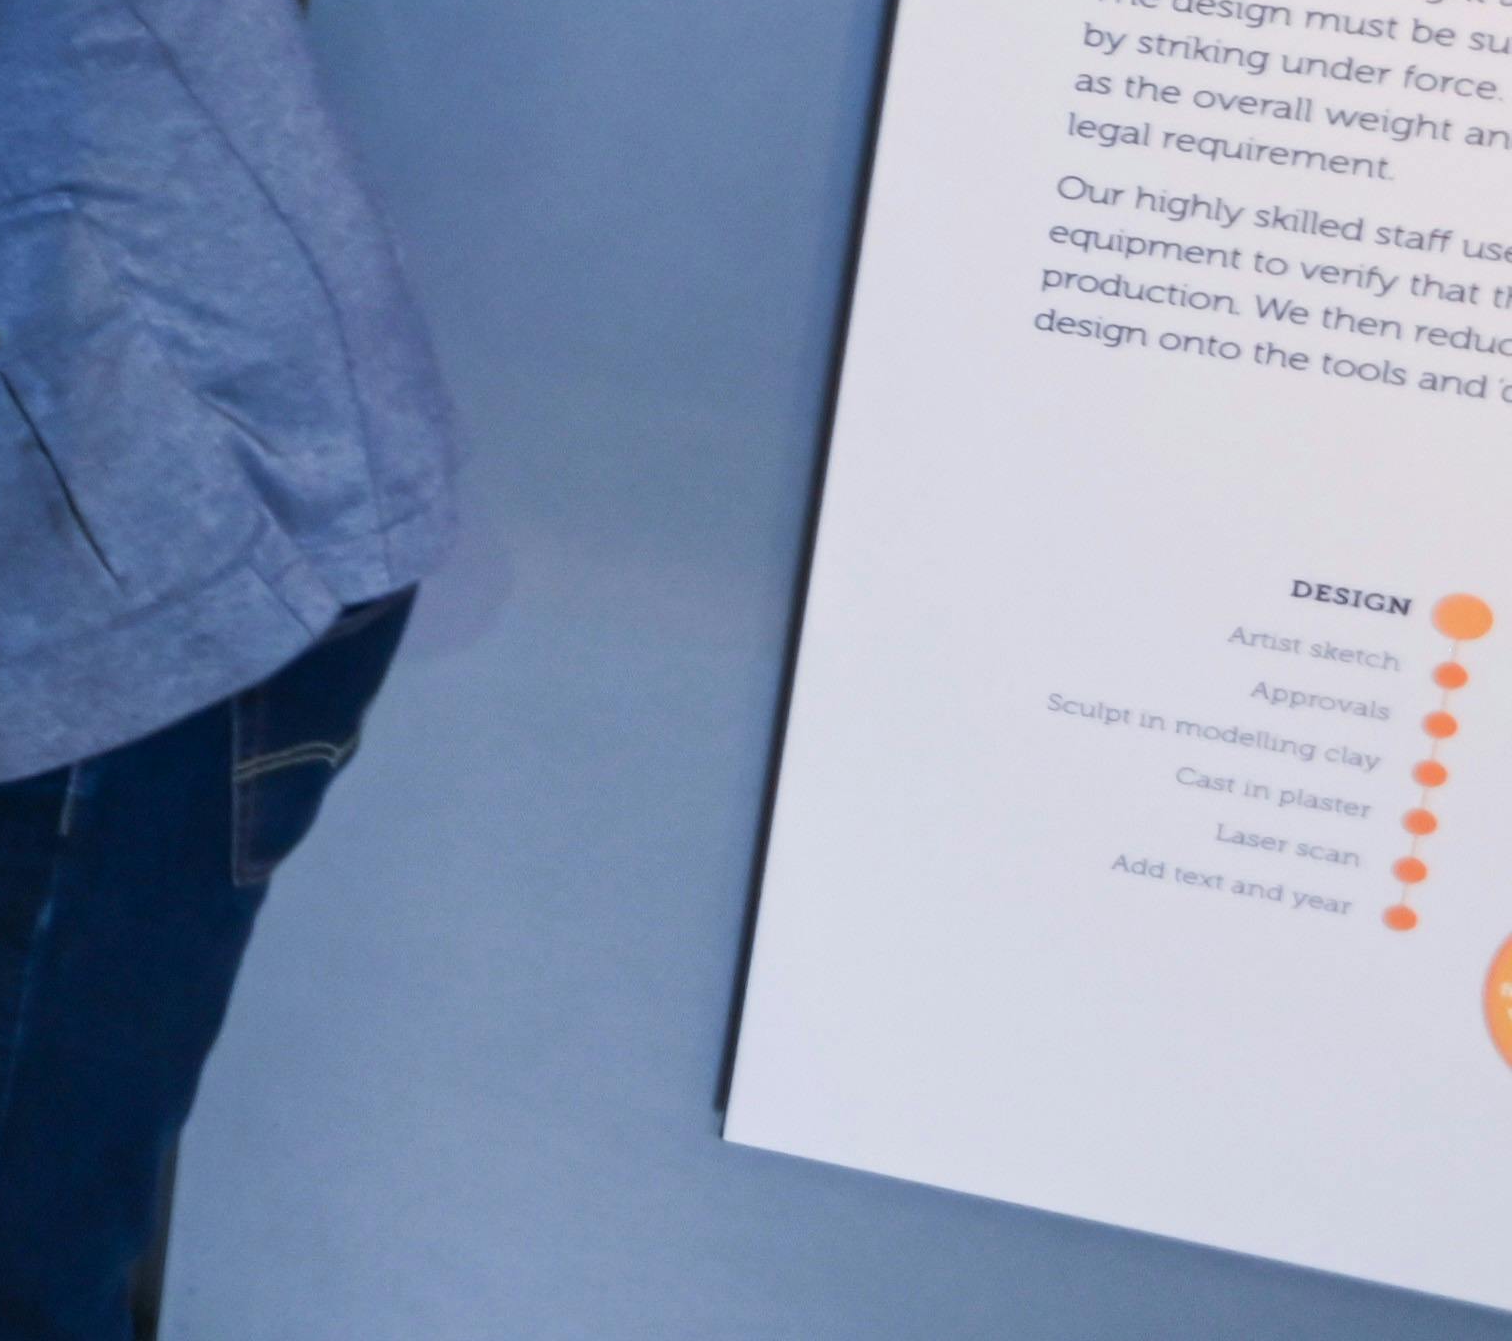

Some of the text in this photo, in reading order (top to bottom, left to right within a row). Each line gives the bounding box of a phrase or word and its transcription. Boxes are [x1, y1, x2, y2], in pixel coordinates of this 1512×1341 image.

[1083, 22, 1504, 102] by striking under force.
[1305, 9, 1397, 39] must
[1411, 18, 1455, 47] be
[1074, 72, 1112, 96] as
[1125, 76, 1181, 105] the
[1192, 87, 1311, 123] overall
[1325, 102, 1451, 142] weight
[1067, 112, 1396, 181] legal requirement.
[1056, 174, 1512, 265] Our highly skilled staff use
[1047, 222, 1242, 271] equipment
[1253, 251, 1289, 277] to
[1300, 260, 1400, 298] verify
[1410, 273, 1479, 306] that
[1040, 267, 1241, 317] production.
[1255, 294, 1310, 326] We
[1321, 306, 1402, 341] then
[1033, 308, 1148, 349] design
[1159, 328, 1241, 361] onto
[1253, 341, 1310, 372] the
[1322, 353, 1408, 387] tools
[1417, 370, 1487, 401] and
[1289, 578, 1413, 617] DESIGN
[1226, 625, 1401, 672] Artist sketch
[1047, 692, 1382, 774] Sculpt in modelling clay
[1249, 680, 1391, 722] Approvals
[1175, 765, 1373, 821] Cast in plaster
[1214, 822, 1360, 868] Laser scan
[1110, 853, 1353, 916] Add text and year
